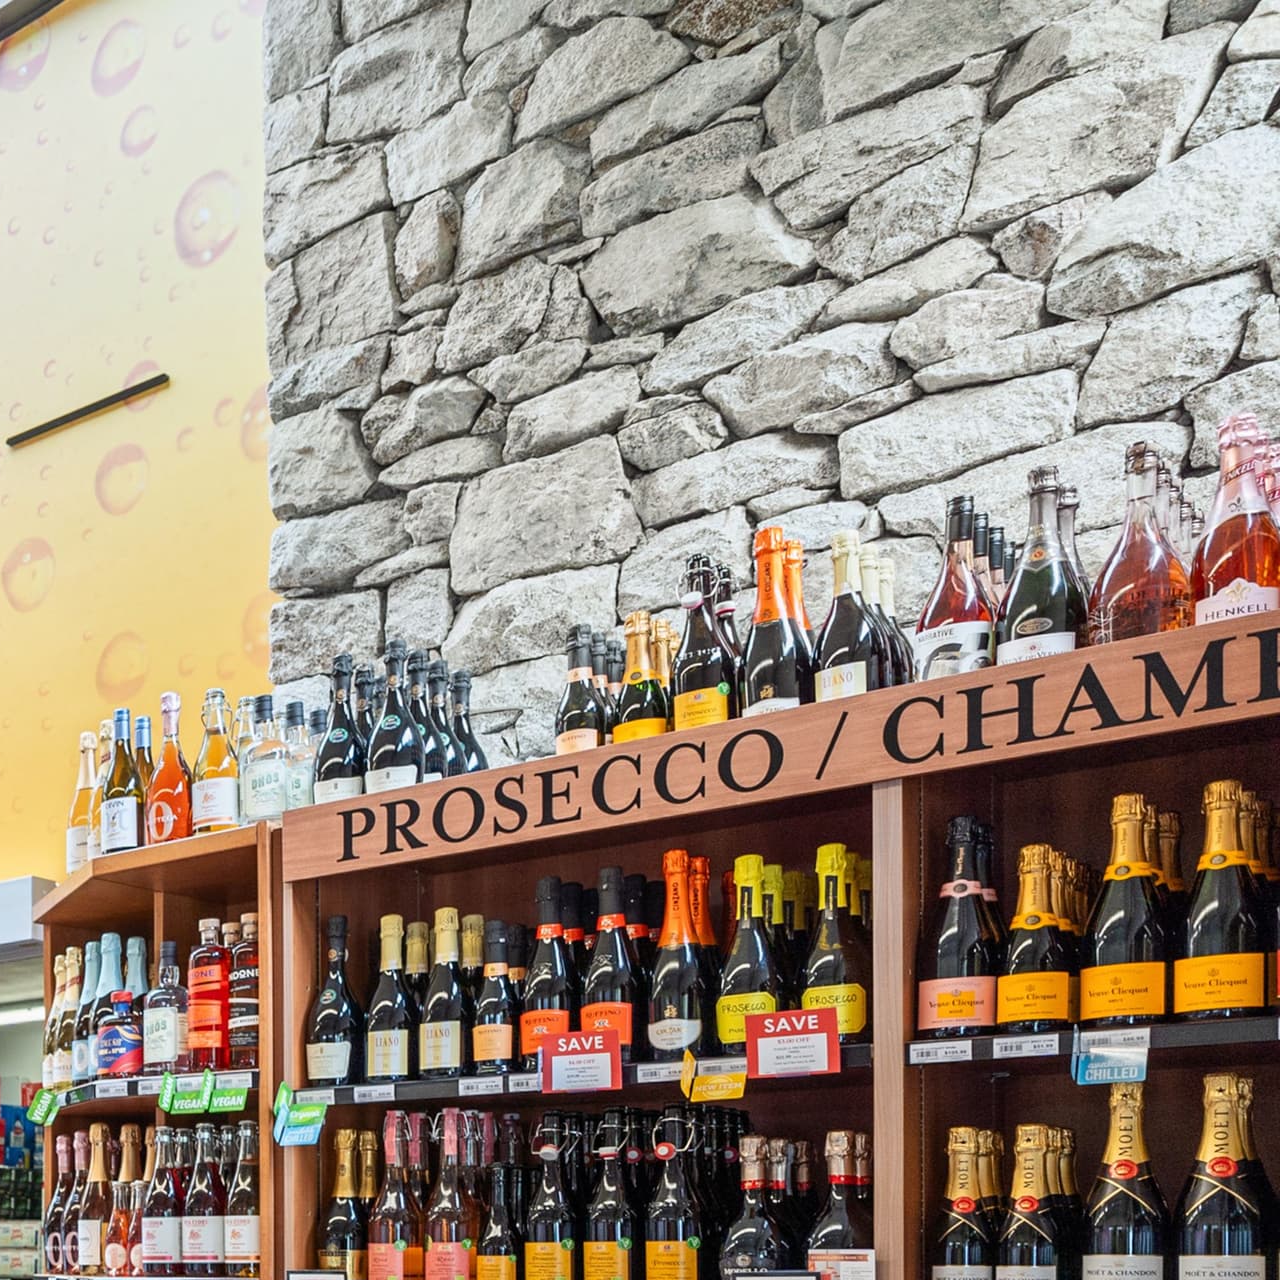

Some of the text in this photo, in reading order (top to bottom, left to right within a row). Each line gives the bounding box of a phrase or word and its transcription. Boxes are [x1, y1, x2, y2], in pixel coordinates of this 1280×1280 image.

[336, 728, 787, 864] PROSECCO
[816, 710, 849, 782] /
[808, 993, 859, 1006] PROSECCO
[721, 1001, 767, 1014] PROSECCO
[764, 1014, 820, 1033] SAVE
[557, 1036, 604, 1052] SAVE
[1084, 1067, 1138, 1081] CHILLED
[694, 1081, 744, 1094] NEW ITEM
[173, 1097, 206, 1110] VEGAN
[213, 1094, 244, 1108] VEGAN
